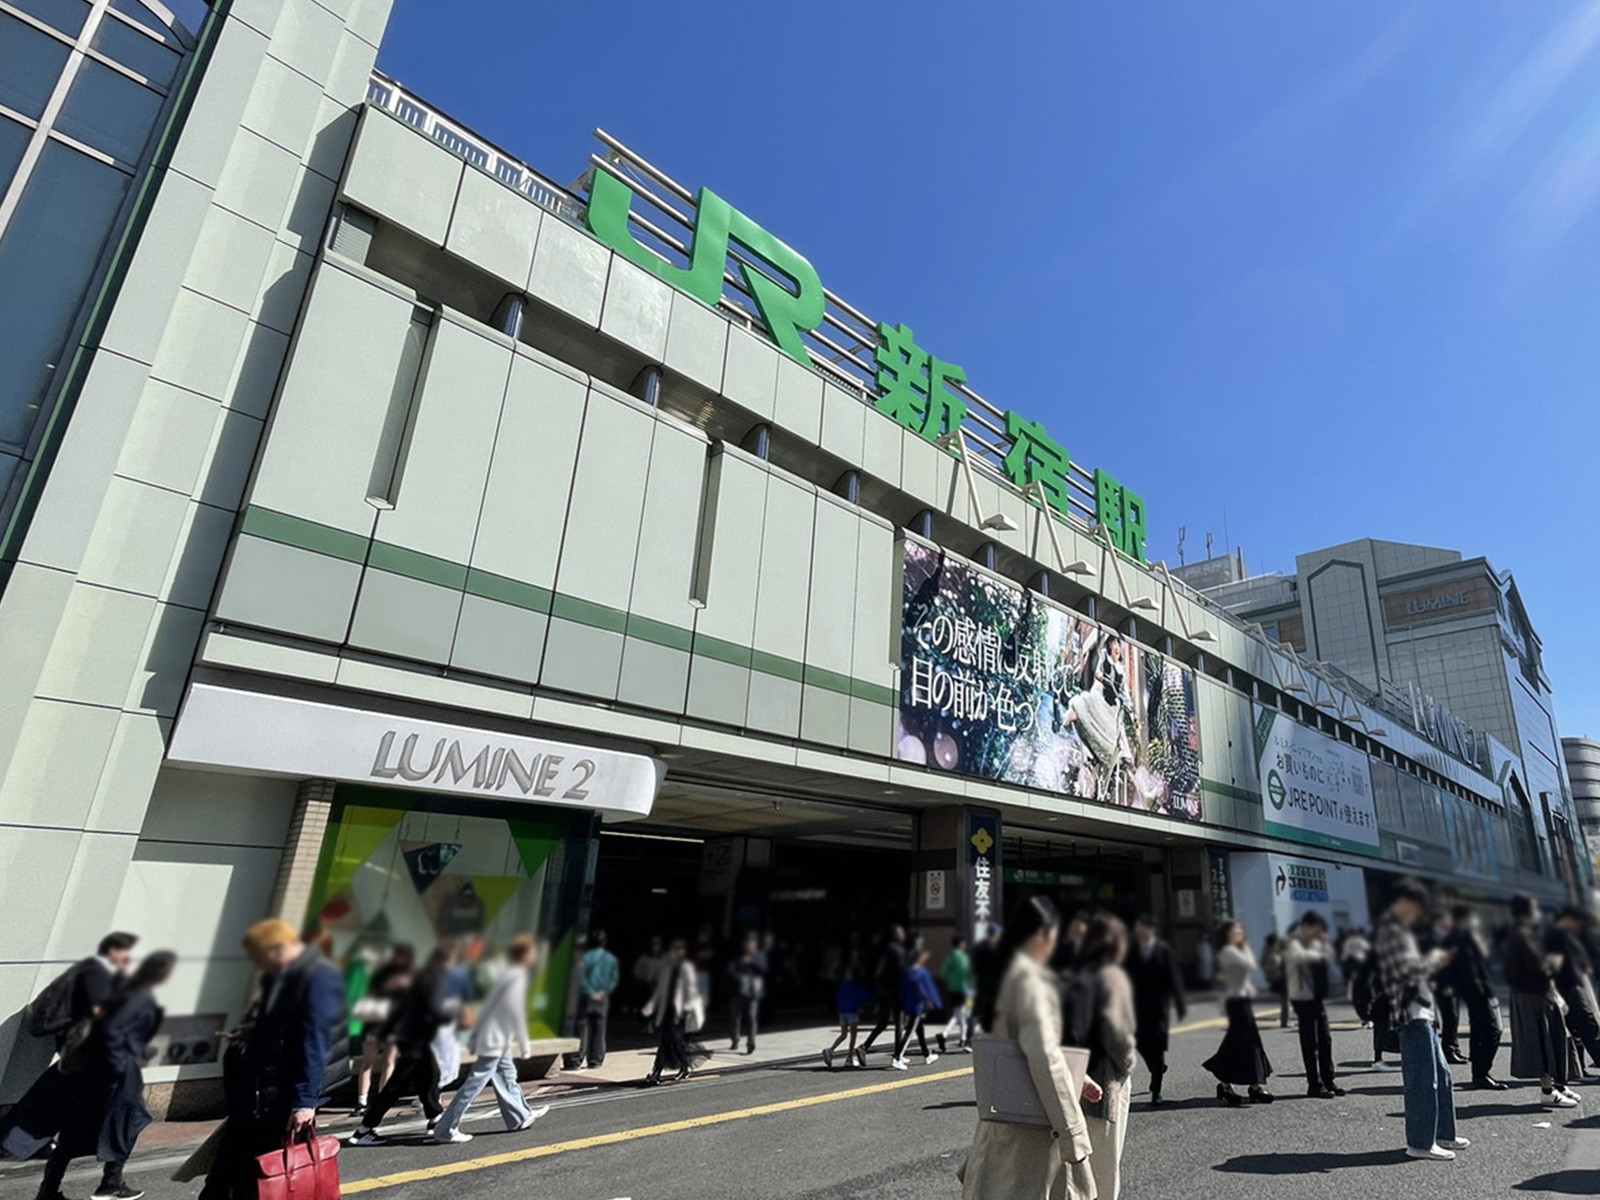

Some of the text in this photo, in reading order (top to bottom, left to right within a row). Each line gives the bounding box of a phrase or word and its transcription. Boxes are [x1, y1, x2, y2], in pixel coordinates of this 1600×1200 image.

[585, 166, 826, 366] JR
[871, 321, 1147, 562] 新宿駅
[1407, 591, 1470, 615] LUMINE
[370, 730, 595, 800] LUMINE 2
[974, 856, 991, 942] 住友不
